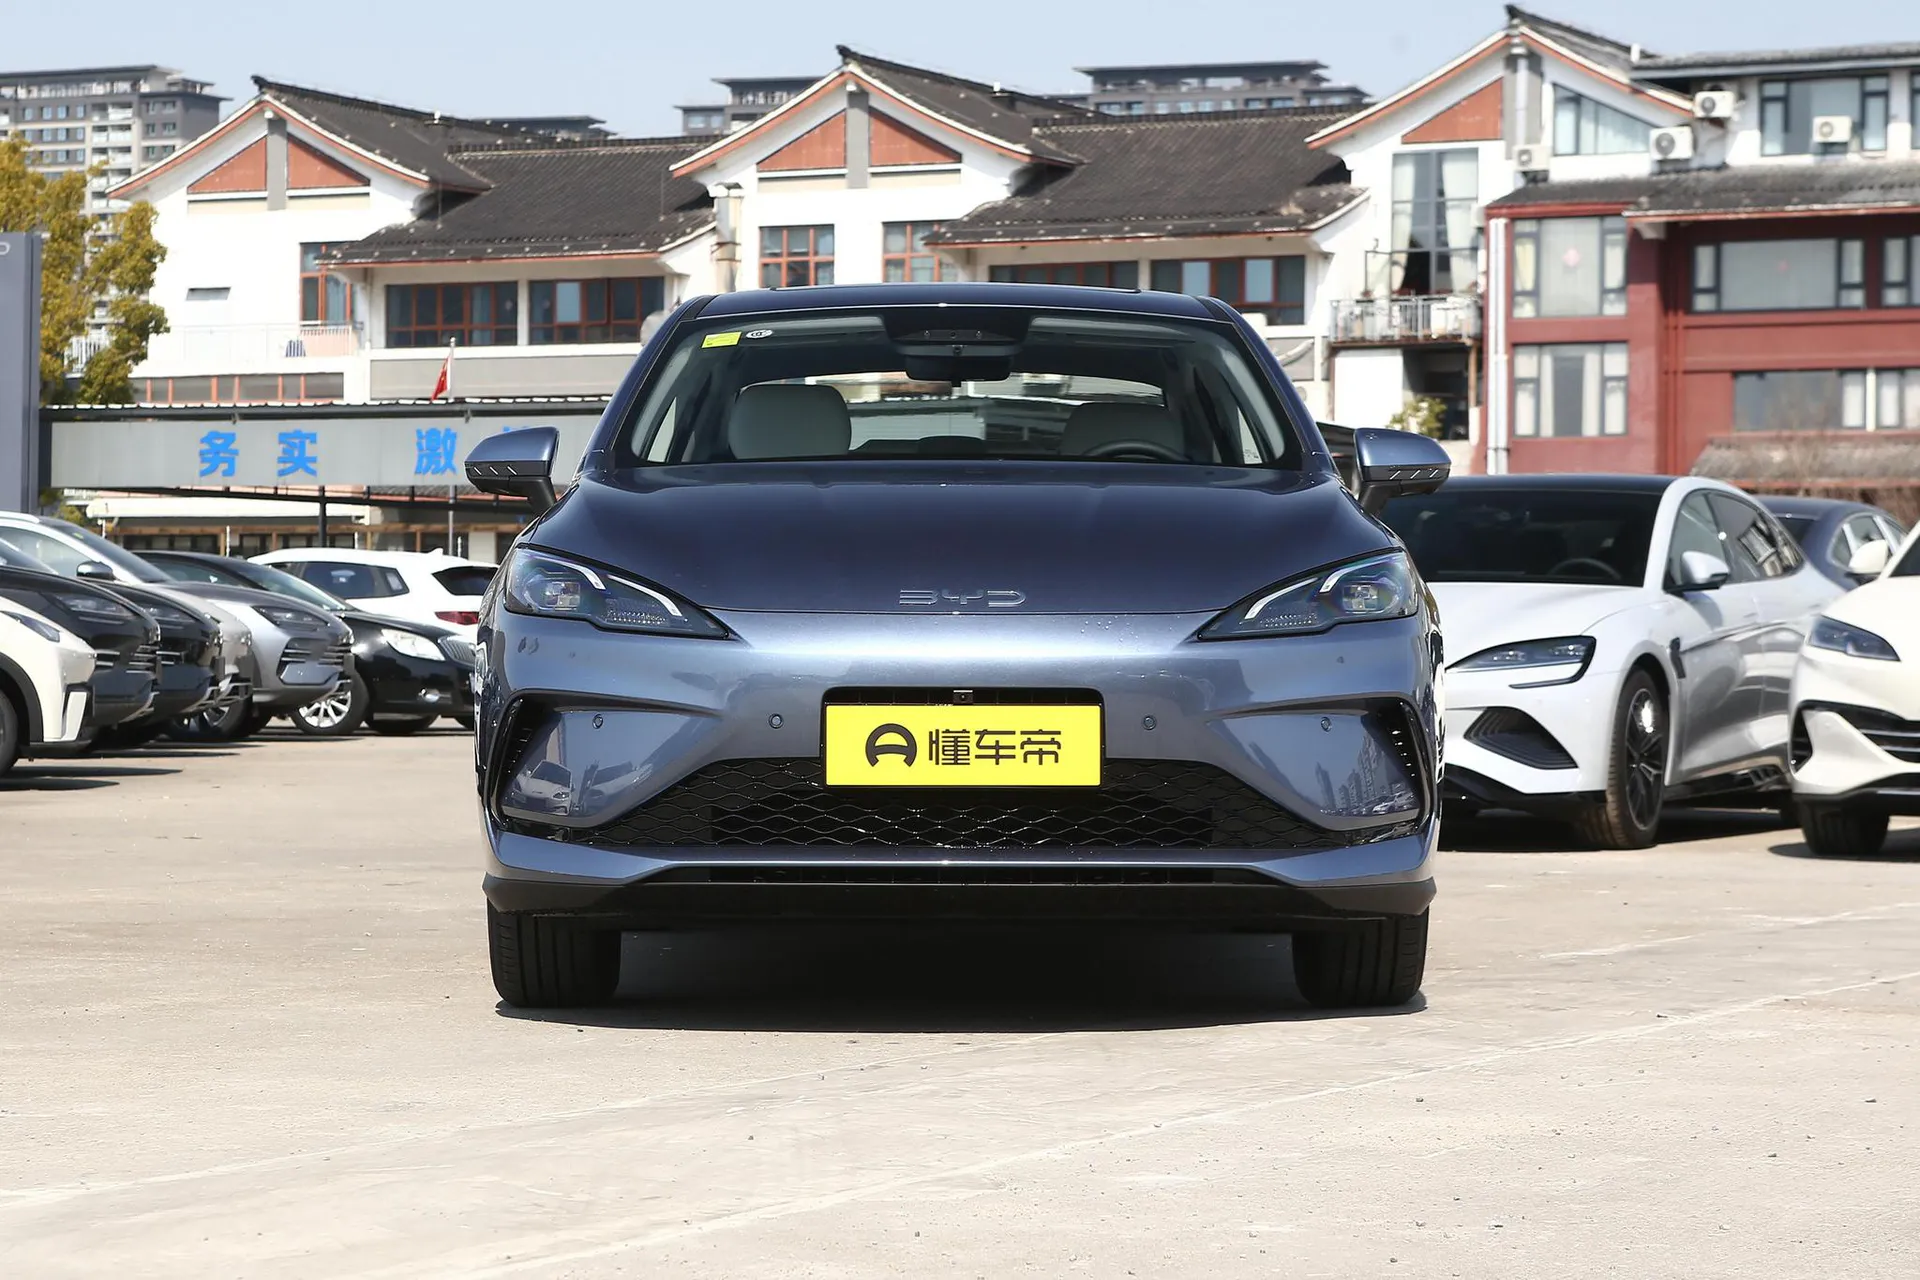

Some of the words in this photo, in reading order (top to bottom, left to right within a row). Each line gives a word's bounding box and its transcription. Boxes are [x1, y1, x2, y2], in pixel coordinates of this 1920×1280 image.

[198, 428, 319, 478] 务实
[899, 589, 1026, 607] BYD
[928, 728, 1062, 766] 懂车帝
